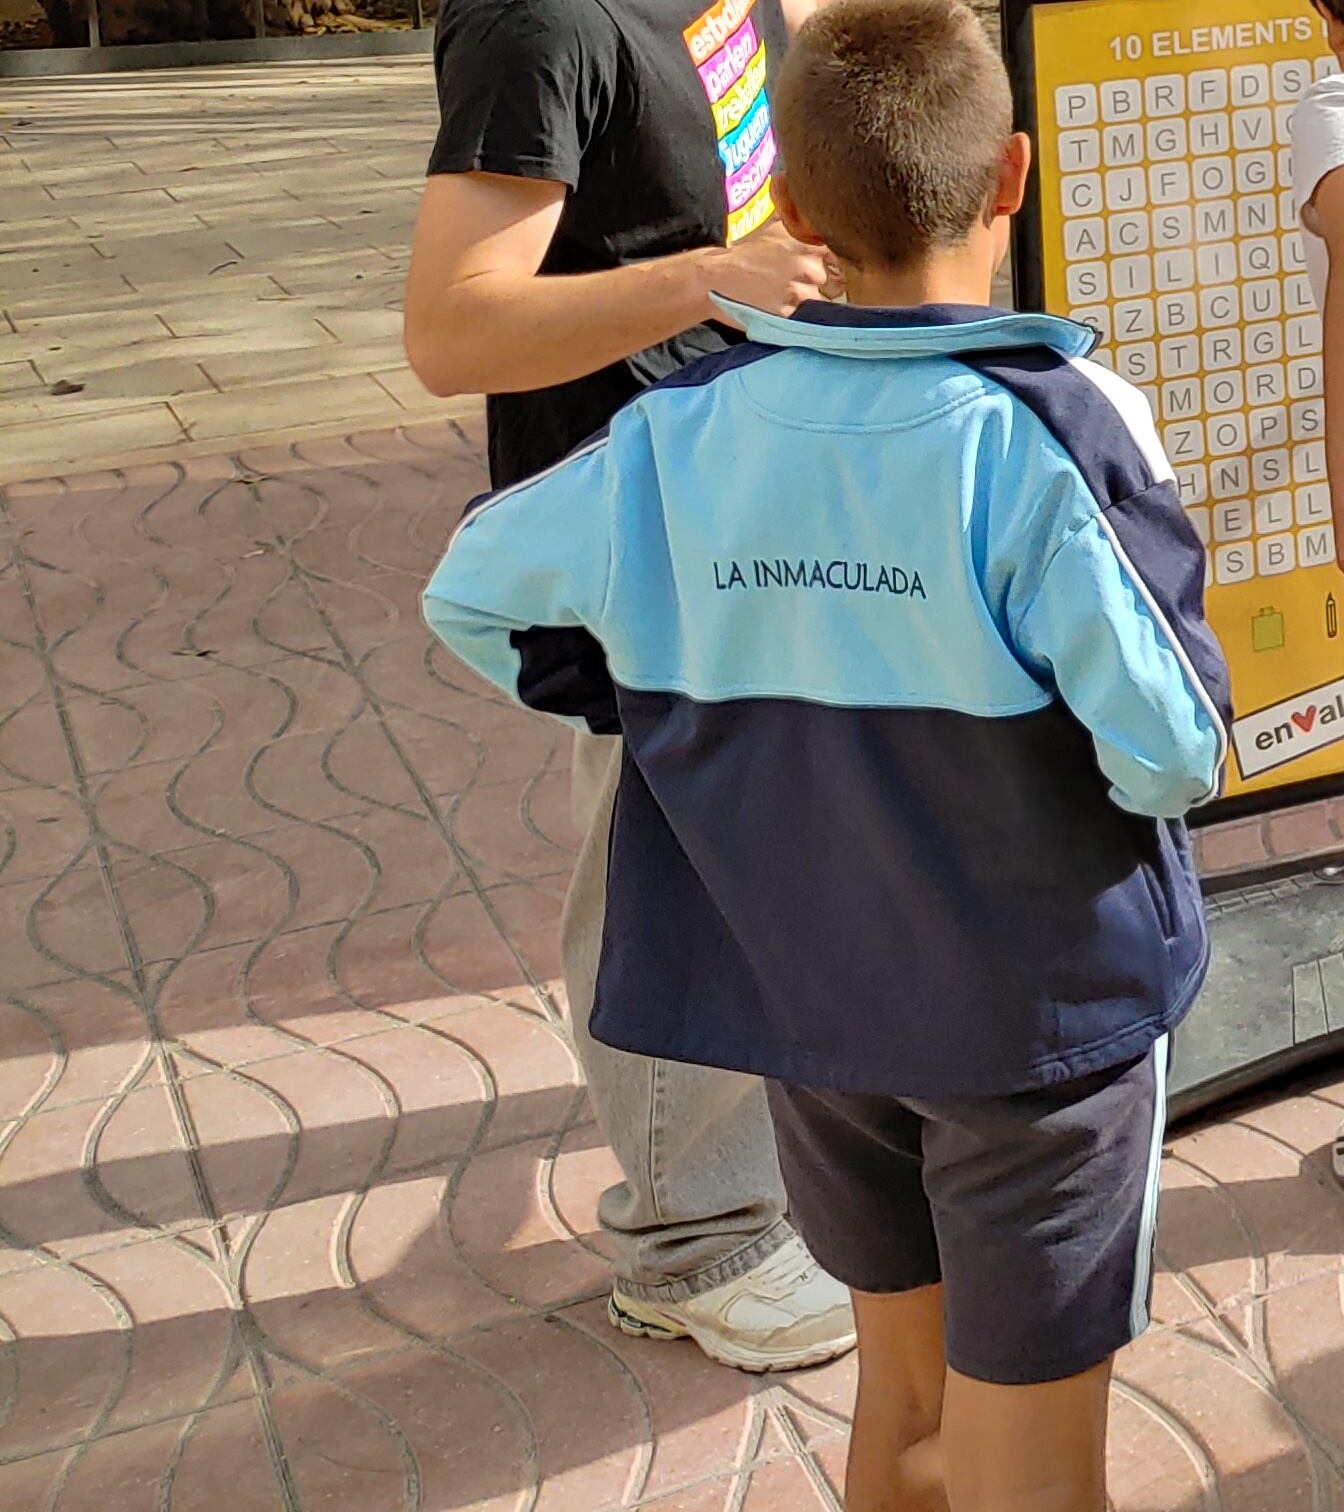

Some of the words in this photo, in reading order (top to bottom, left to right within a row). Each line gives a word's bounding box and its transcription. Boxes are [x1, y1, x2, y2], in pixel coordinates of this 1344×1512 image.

[1110, 34, 1142, 60] 10
[1152, 17, 1312, 57] ELEMENTS
[713, 560, 747, 590] LA
[753, 559, 927, 600] INMACULADA
